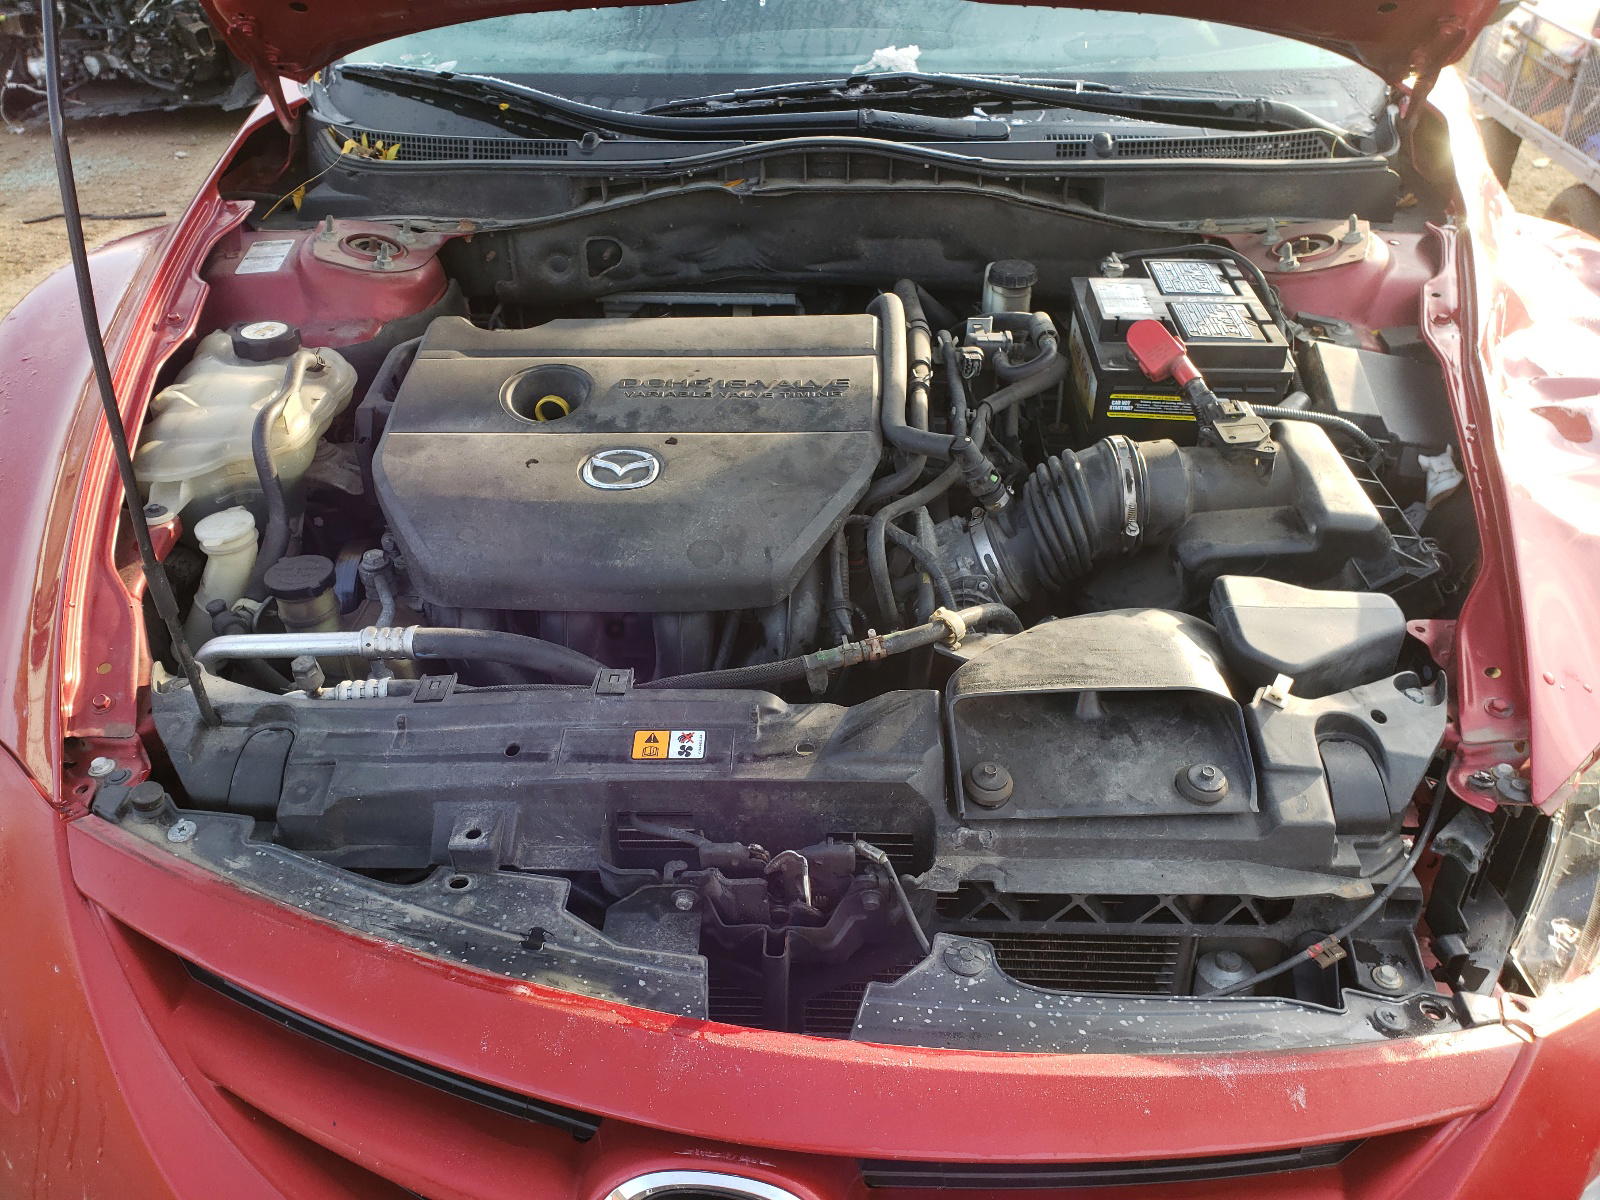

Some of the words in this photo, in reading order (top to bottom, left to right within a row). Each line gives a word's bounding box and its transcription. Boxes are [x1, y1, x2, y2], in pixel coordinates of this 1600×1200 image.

[618, 378, 713, 389] DOHC
[623, 391, 713, 399] VARIABLE
[719, 391, 775, 399] VALVE
[779, 391, 843, 399] TIMING
